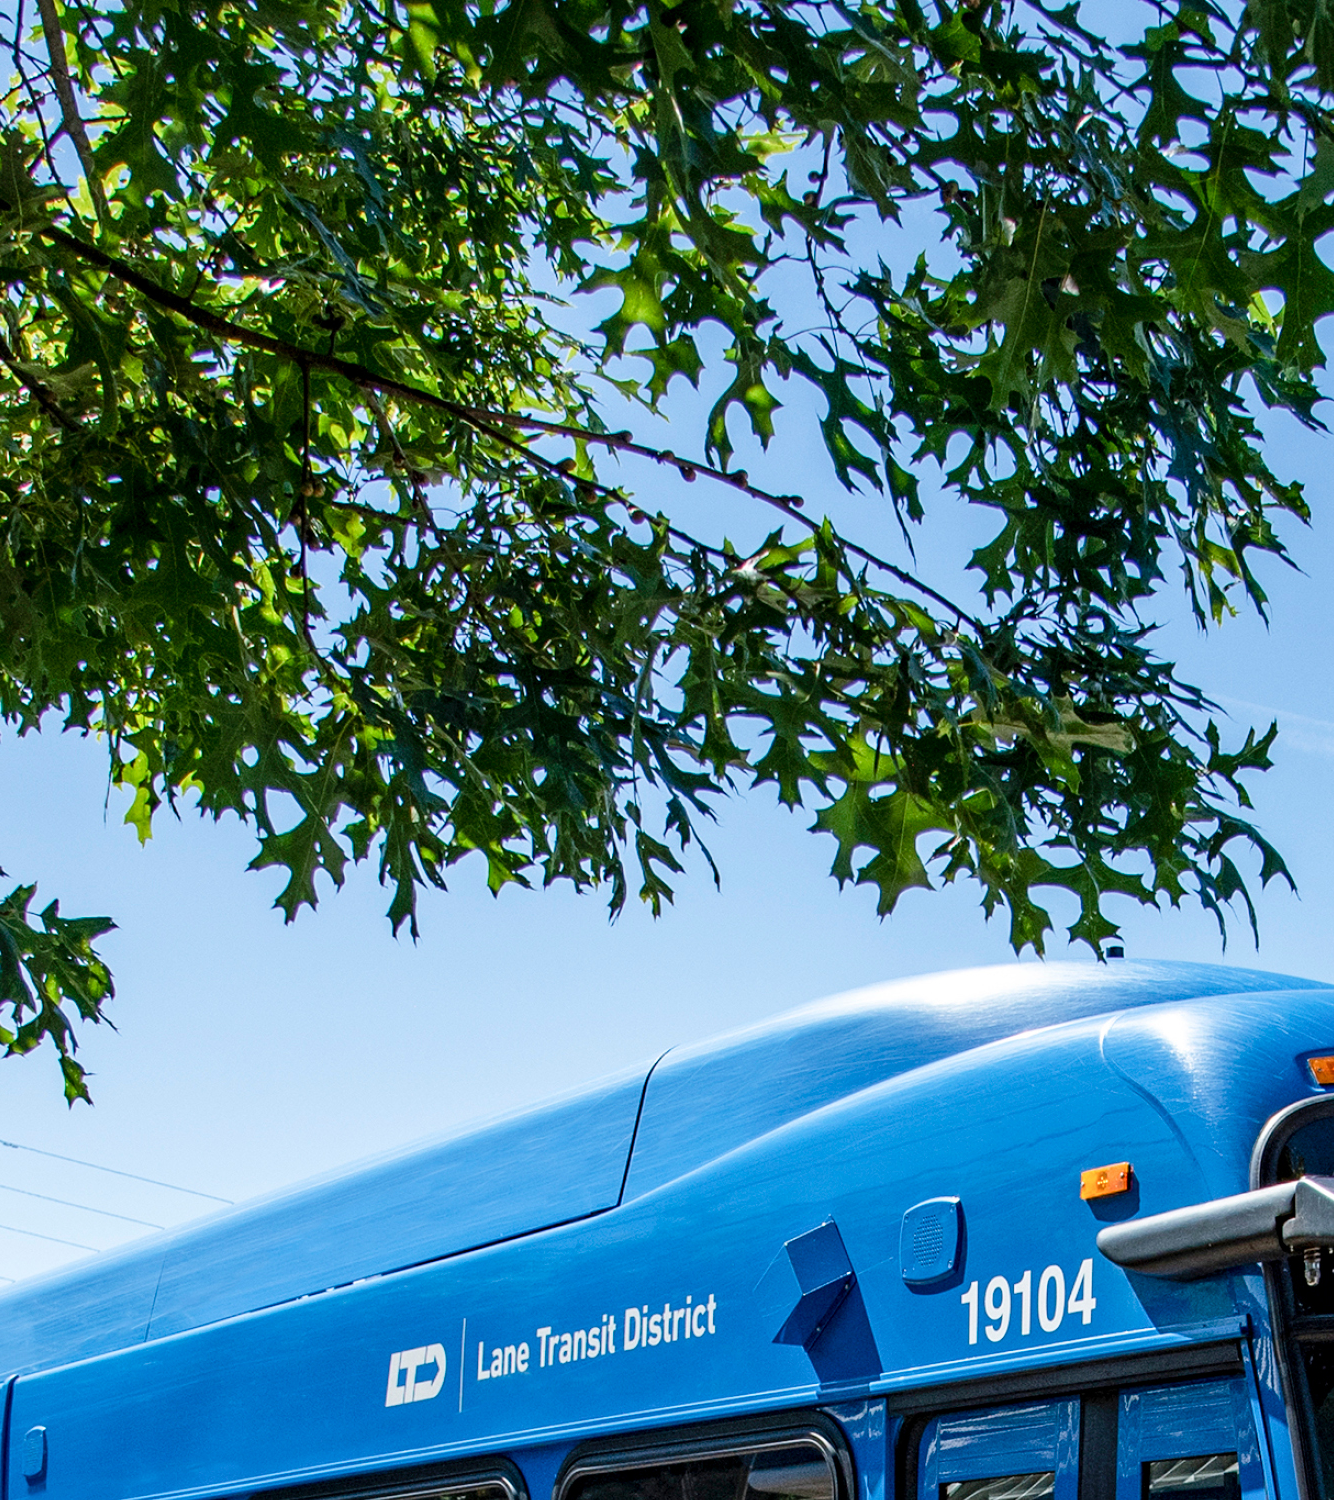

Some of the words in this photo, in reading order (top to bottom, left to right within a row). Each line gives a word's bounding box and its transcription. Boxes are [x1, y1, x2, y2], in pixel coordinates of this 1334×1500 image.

[477, 1341, 529, 1381] Lane
[536, 1314, 616, 1368] Transit
[623, 1293, 717, 1351] District
[961, 1258, 1097, 1345] 19104
[385, 1343, 447, 1407] LTD
